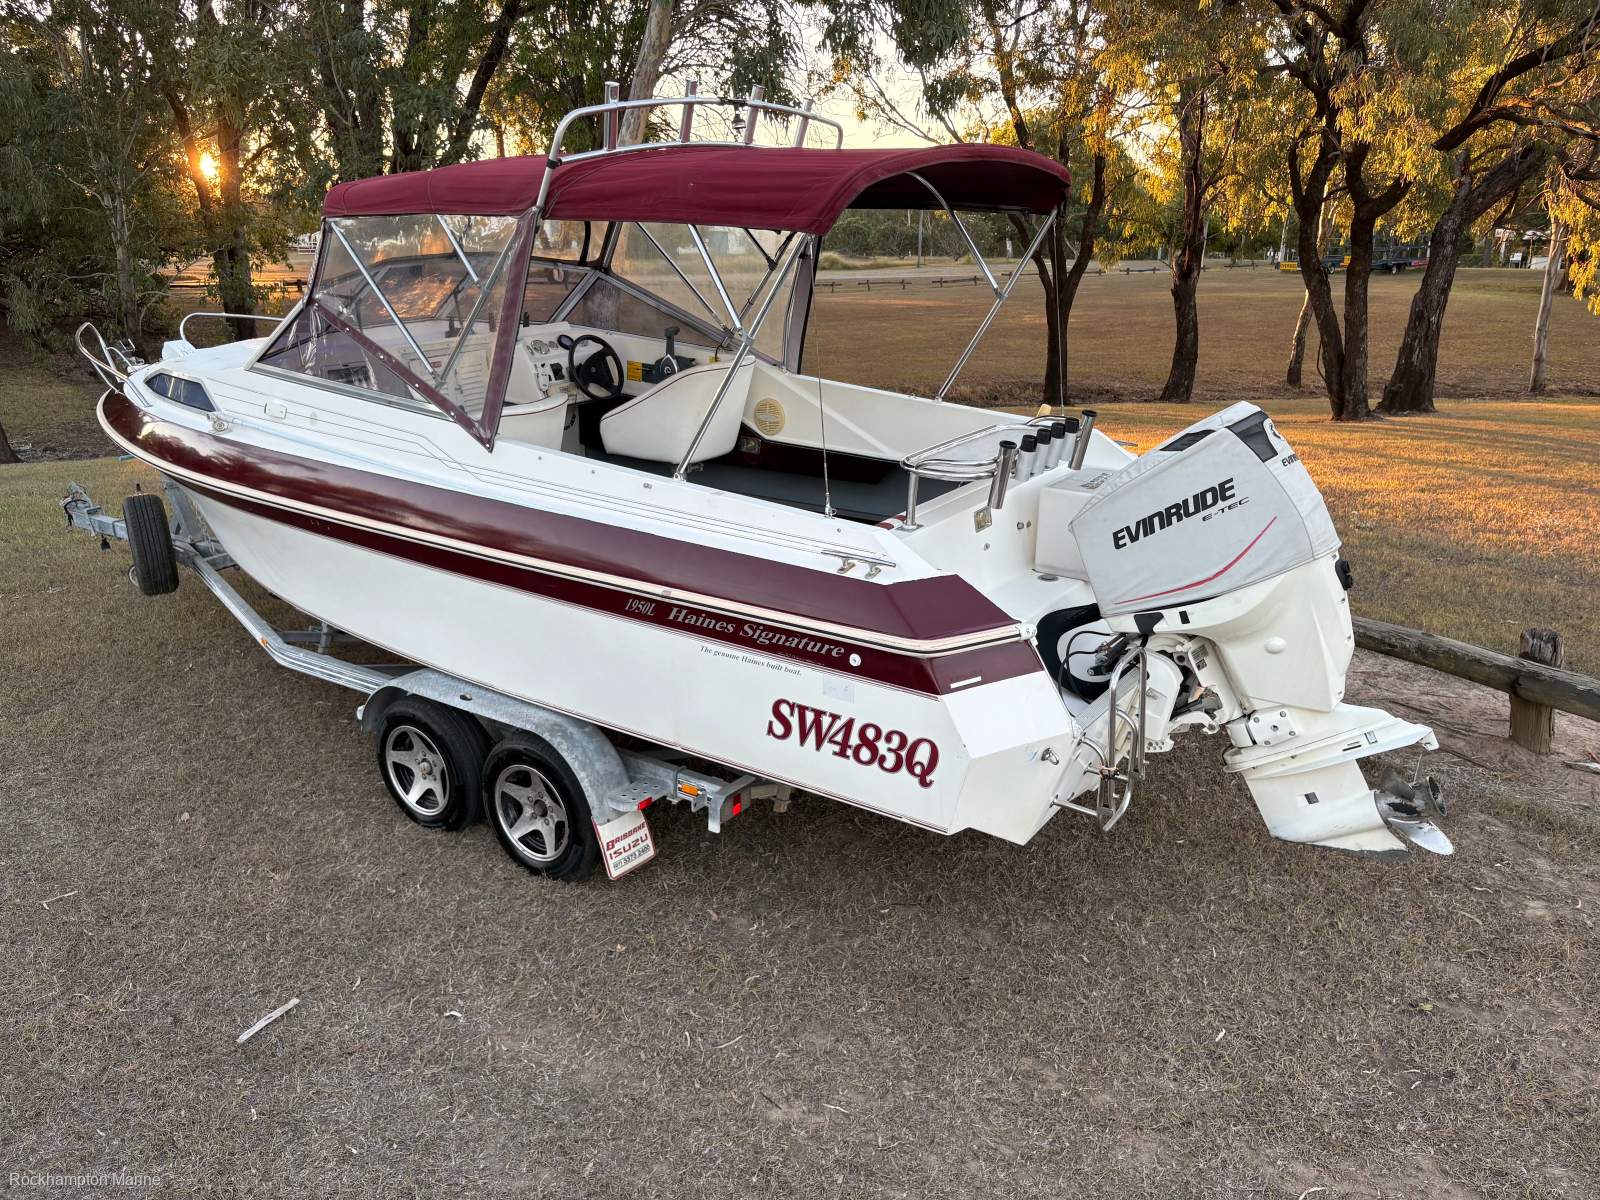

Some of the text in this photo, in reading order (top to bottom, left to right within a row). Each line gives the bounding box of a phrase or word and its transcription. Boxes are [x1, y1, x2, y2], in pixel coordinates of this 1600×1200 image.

[1112, 477, 1236, 550] EVINRUDE
[1202, 497, 1250, 522] E-TEC
[624, 598, 845, 658] 1950L Haines Signature
[700, 645, 713, 654] The
[713, 650, 740, 661] genuine
[741, 655, 766, 667] Haines
[766, 661, 784, 672] built
[766, 698, 940, 788] SW483Q
[609, 833, 649, 860] ISUZU
